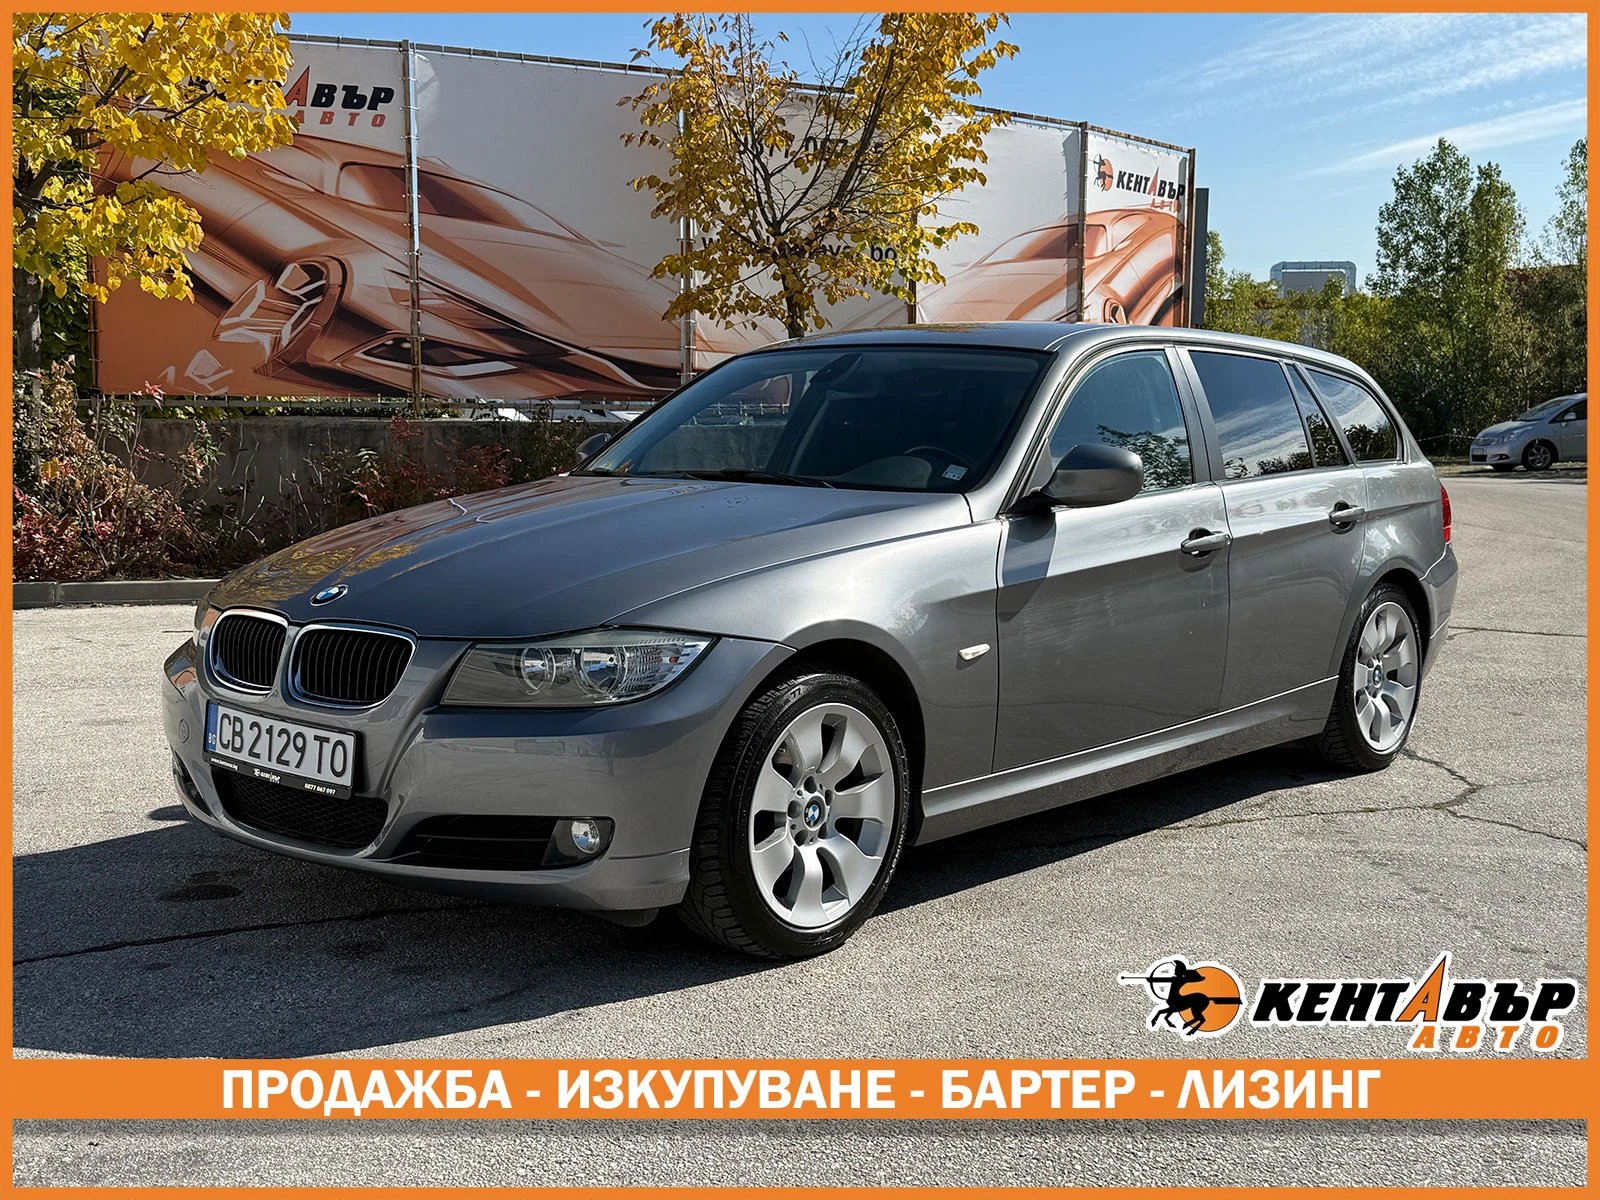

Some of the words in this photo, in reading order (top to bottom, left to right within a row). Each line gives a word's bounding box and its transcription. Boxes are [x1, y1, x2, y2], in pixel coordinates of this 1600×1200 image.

[1116, 166, 1186, 200] КЕНТАВЪР
[219, 713, 244, 753] CB
[248, 721, 307, 769] 2129
[313, 734, 347, 778] TO
